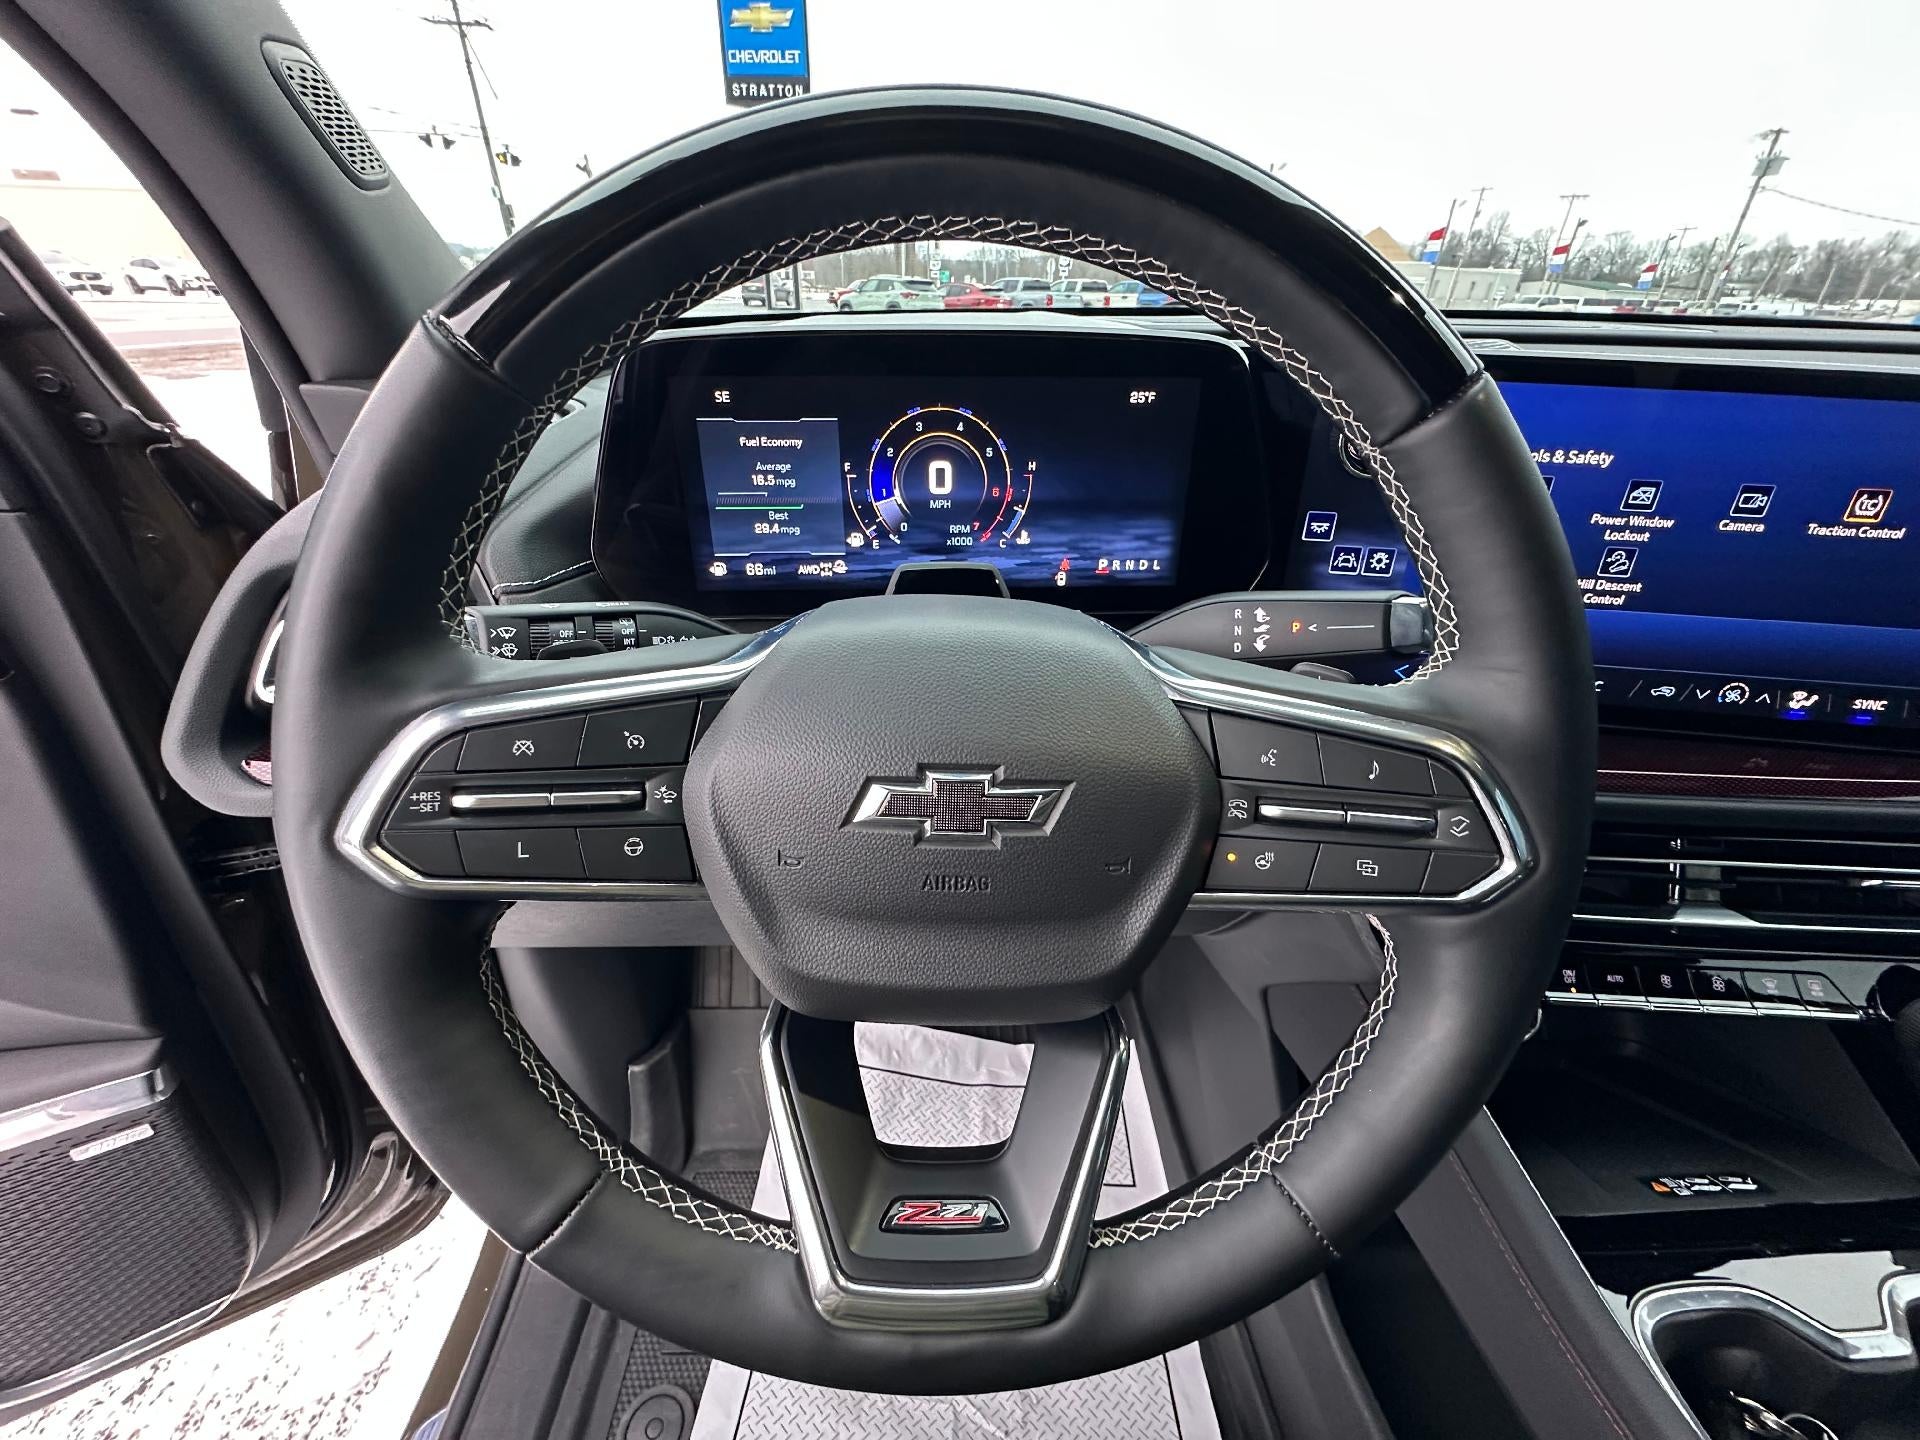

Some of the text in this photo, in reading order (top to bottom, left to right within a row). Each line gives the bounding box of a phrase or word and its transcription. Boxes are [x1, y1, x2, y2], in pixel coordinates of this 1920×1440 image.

[728, 49, 801, 64] CHEVROLET
[732, 83, 804, 98] STRATTON
[714, 390, 731, 403] SE
[1129, 391, 1157, 403] 25°F
[915, 421, 923, 432] 3
[956, 421, 964, 431] 4
[739, 436, 803, 450] Fuel Economy
[886, 448, 894, 457] 2
[985, 447, 993, 457] 5
[1552, 450, 1565, 464] &
[1565, 450, 1615, 468] Safety
[755, 462, 792, 473] Average
[844, 462, 851, 472] F
[1028, 461, 1036, 471] H
[928, 459, 953, 495] 0
[881, 488, 887, 498] 1
[929, 500, 951, 509] MPH
[768, 510, 789, 521] Best
[1590, 512, 1675, 529] Power Window
[900, 522, 908, 532] 0
[949, 524, 971, 534] RPM
[972, 522, 980, 531] 7
[1718, 519, 1765, 533] Camera
[1808, 523, 1906, 540] Traction Control
[1603, 529, 1651, 542] Lockout
[872, 539, 880, 550] E
[946, 536, 973, 547] x1000
[999, 538, 1007, 548] C
[797, 564, 820, 576] AWD
[1098, 558, 1161, 571] P R N D L
[1577, 578, 1642, 593] Hill Descent
[1583, 593, 1626, 606] Control
[1234, 608, 1242, 619] R
[1234, 625, 1242, 636] N
[1291, 621, 1301, 633] P
[559, 630, 574, 638] OFF
[623, 637, 636, 646] INT
[1233, 642, 1242, 653] D
[1852, 698, 1889, 711] SYNC
[409, 791, 441, 802] +RES
[517, 841, 530, 858] L
[920, 874, 992, 893] AIRBAG
[1606, 974, 1625, 983] AUTO
